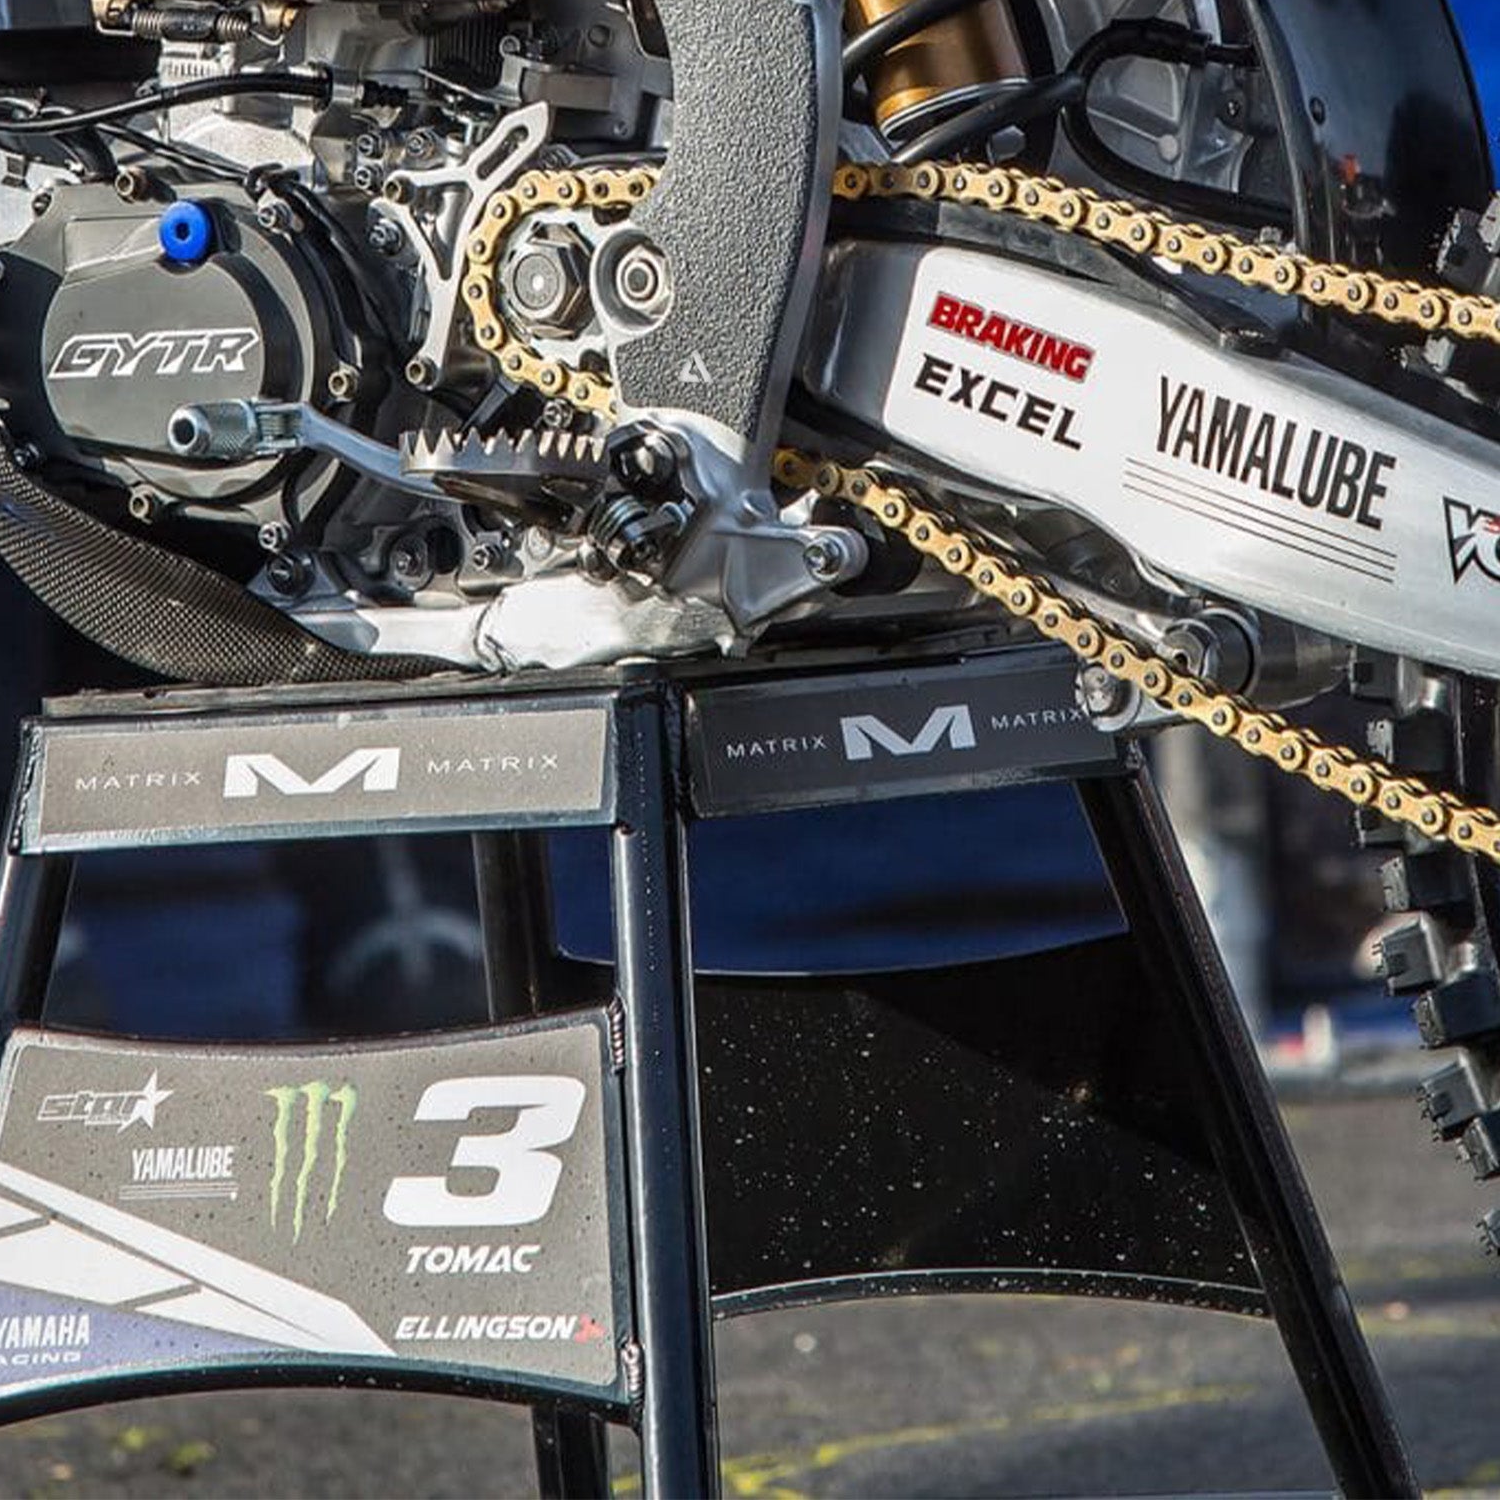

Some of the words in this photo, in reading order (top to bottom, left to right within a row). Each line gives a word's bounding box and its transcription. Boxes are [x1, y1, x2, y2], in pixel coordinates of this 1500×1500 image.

[48, 327, 260, 380] GYTR
[926, 290, 1096, 385] BRAKING
[913, 352, 1083, 452] EXCEL
[1156, 375, 1398, 532] YAMALUBE
[726, 735, 828, 760] MATRIX
[840, 704, 977, 761] M
[991, 707, 1085, 731] MATRIX
[75, 770, 202, 792] MATRIX
[223, 746, 401, 798] M
[427, 754, 559, 776] MATRIX
[132, 1145, 235, 1181] YAMALUBE
[383, 1075, 587, 1227] 3
[405, 1244, 541, 1274] TOMAC
[395, 1314, 578, 1341] ELLINGSON
